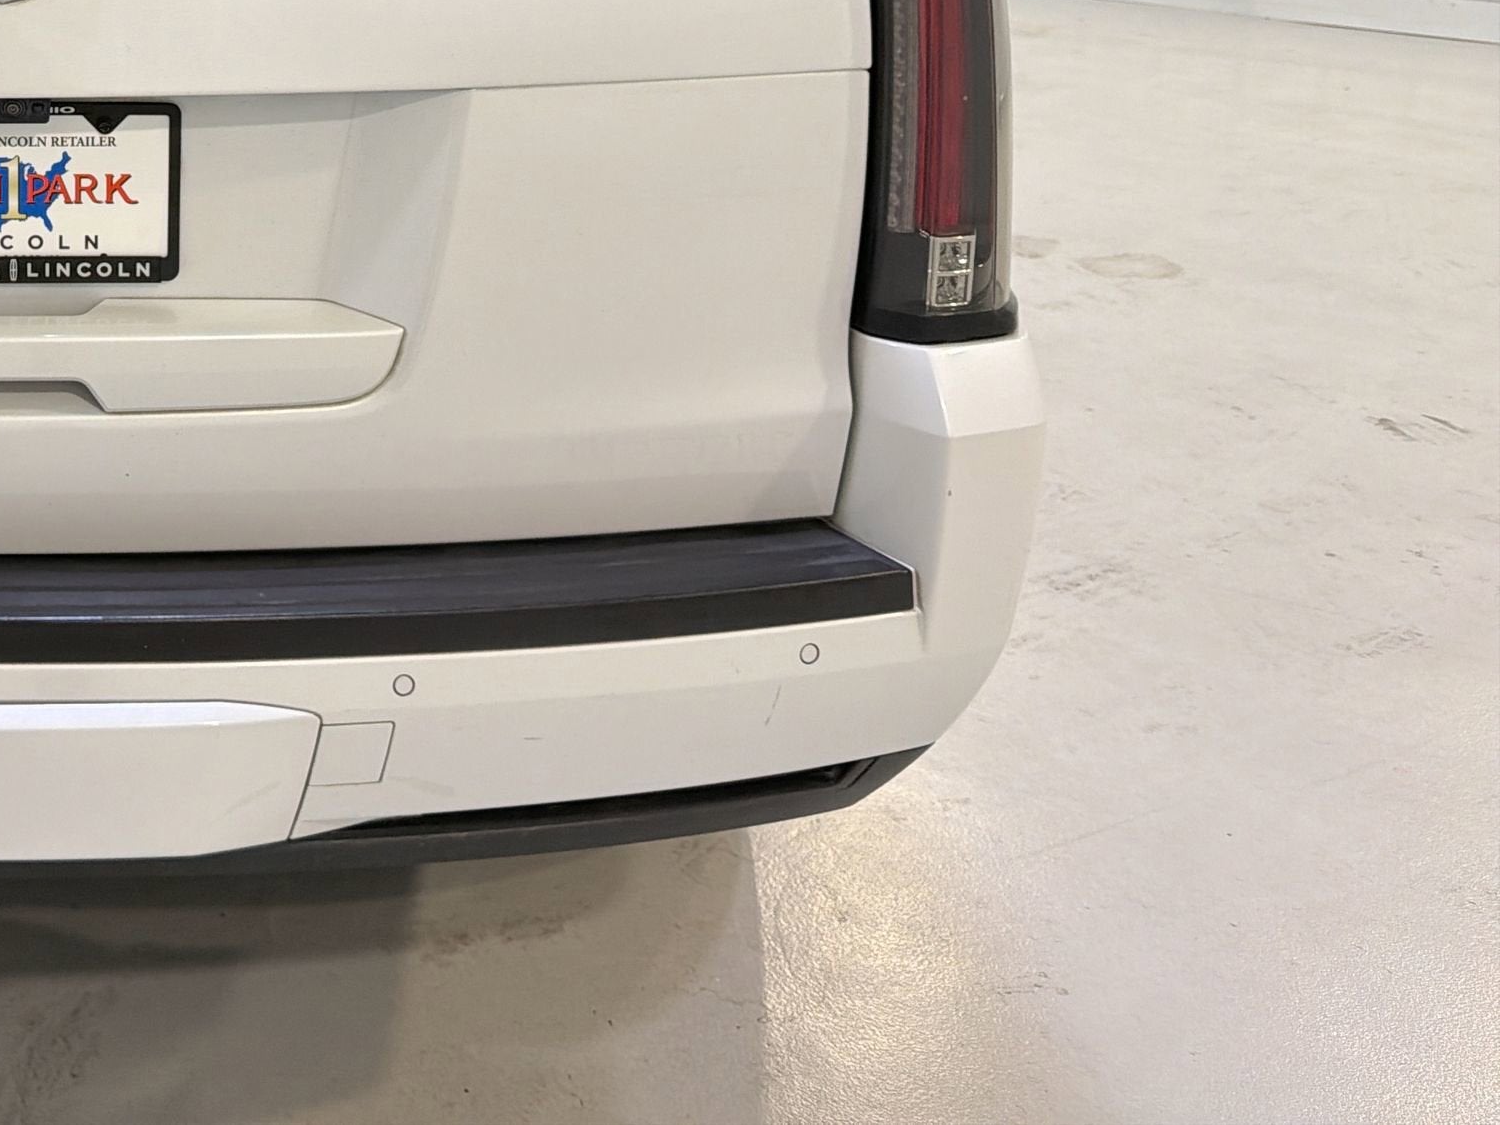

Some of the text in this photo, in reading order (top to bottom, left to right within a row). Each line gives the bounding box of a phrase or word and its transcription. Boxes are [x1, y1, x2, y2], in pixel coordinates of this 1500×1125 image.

[51, 135, 117, 148] RETAILER
[26, 173, 140, 205] PARK
[26, 261, 151, 278] LINCOLN
